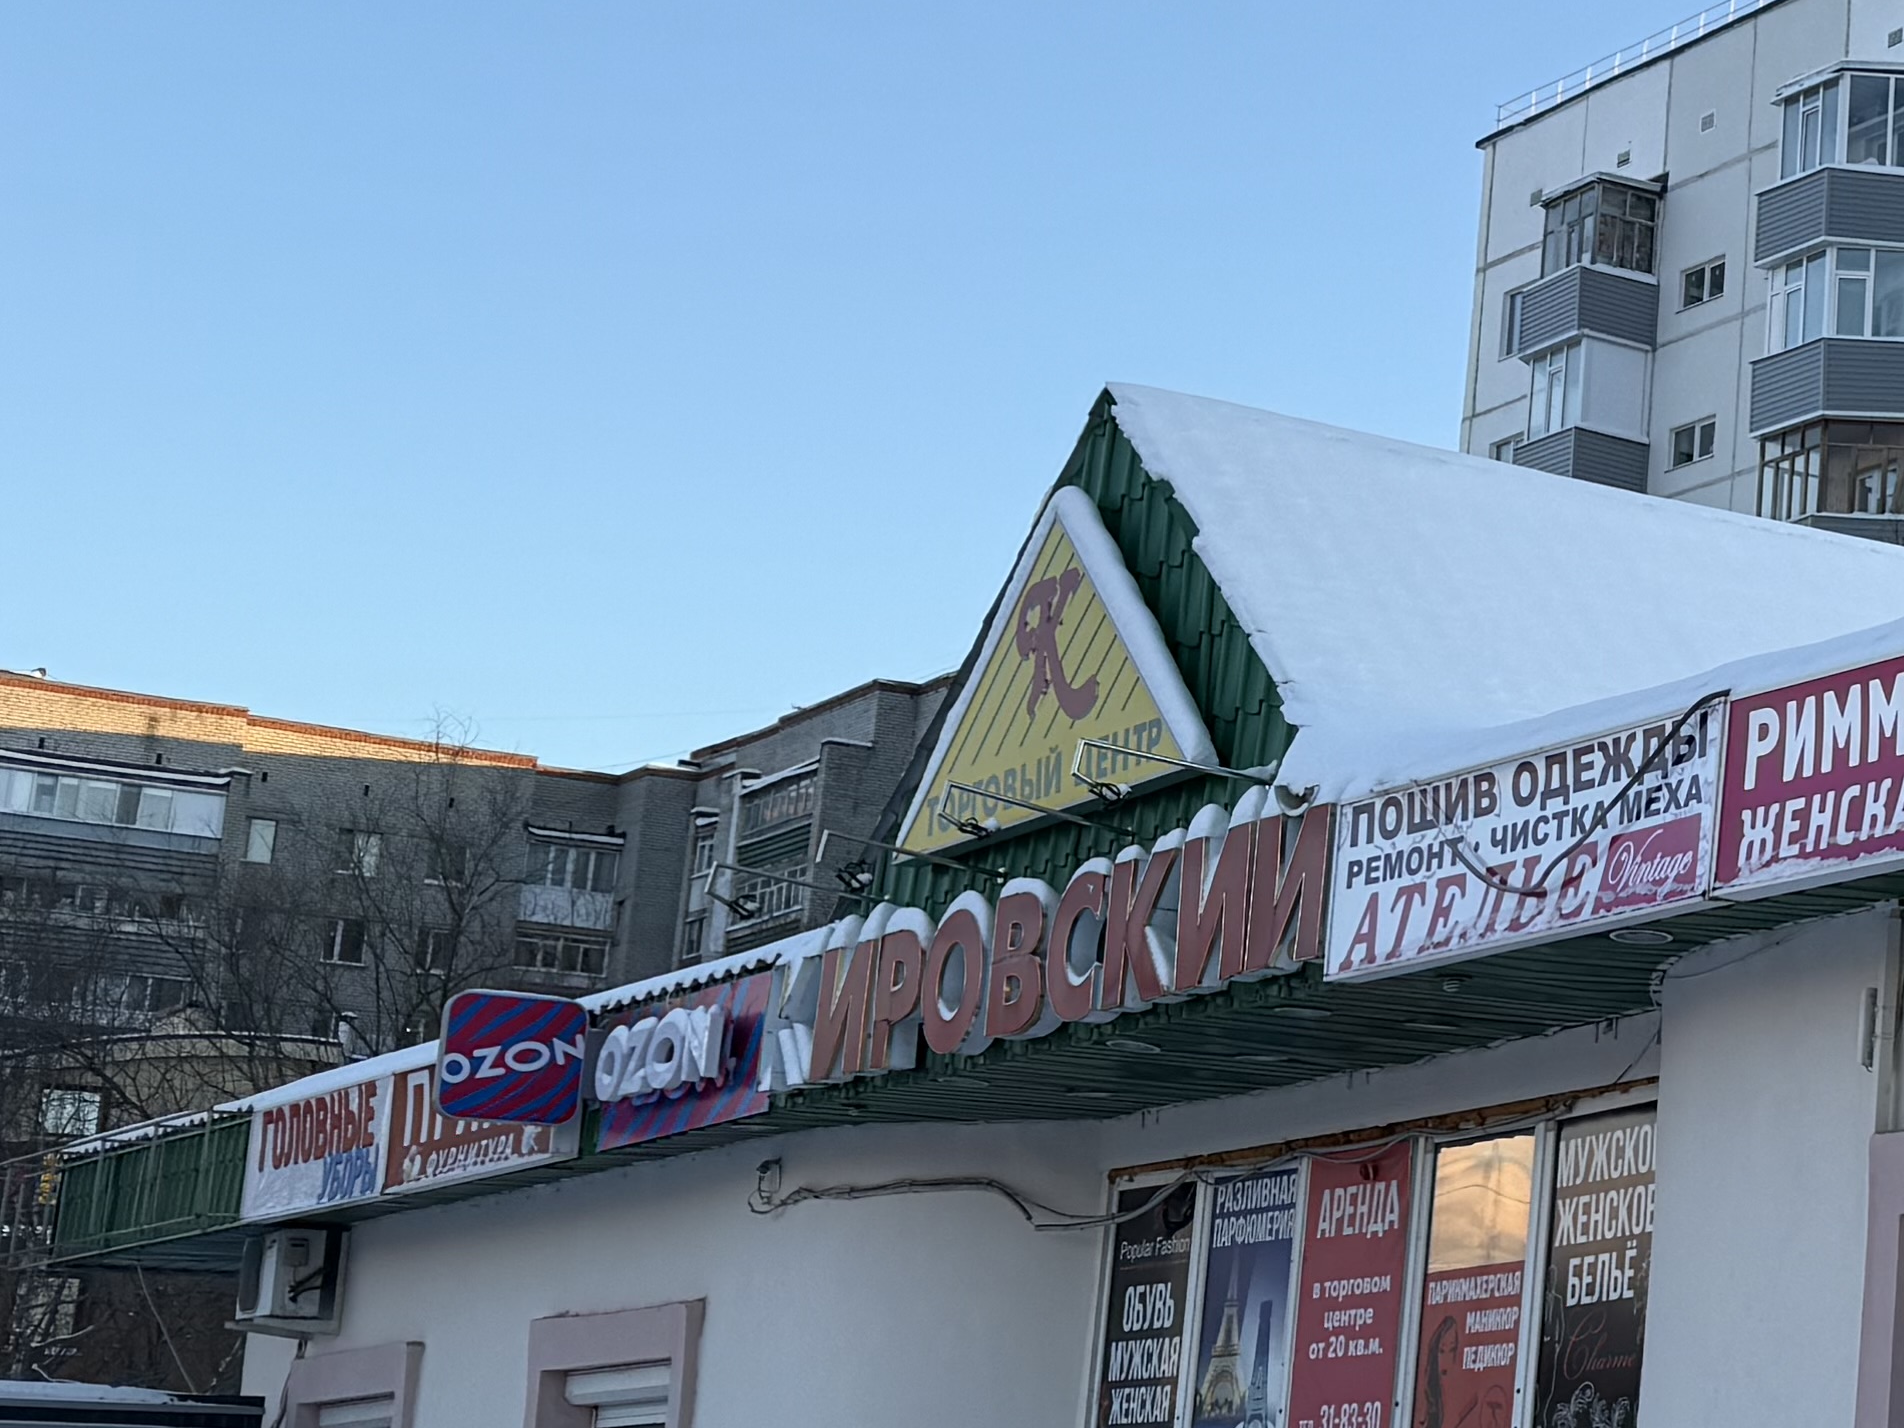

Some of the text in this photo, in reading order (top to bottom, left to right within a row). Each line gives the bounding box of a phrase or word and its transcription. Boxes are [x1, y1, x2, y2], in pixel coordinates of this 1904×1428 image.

[927, 744, 1062, 837] ТОРГОВЫЙ
[1350, 711, 1709, 848] ПОШИВ ОДЕЖДЫ
[1346, 774, 1702, 889] РЕМОНТ ЧИСТКА МЕХА
[1609, 829, 1693, 902] Vintage
[1339, 840, 1600, 973] АТЕЛЬЕ
[757, 784, 1338, 1093] КИРОВСКИЙ
[440, 1034, 585, 1084] OZON
[595, 1004, 727, 1103] OZON
[258, 1080, 378, 1173] ГОЛОВНЫЕ
[317, 1143, 380, 1205] УБОРЫ
[1557, 1123, 1657, 1188] МУЖСКО
[1216, 1174, 1297, 1214] РАЗЛИВНАЯ
[1316, 1180, 1400, 1238] АРЕНДА
[1120, 1239, 1154, 1263] Popular
[1212, 1208, 1296, 1248] ПАРФЮМЕРИЯ
[1324, 1275, 1391, 1301] торговом
[1566, 1241, 1638, 1308] БЕЛЬЁ
[1122, 1281, 1175, 1332] ОБУВЬ
[1323, 1308, 1374, 1331] центре
[1465, 1306, 1519, 1333] МАНИКЮР
[1108, 1336, 1181, 1382] МУЖСКАЯ
[1308, 1342, 1326, 1359] от
[1327, 1336, 1346, 1357] 20
[1462, 1342, 1515, 1371] ПЕДИКЮР
[1109, 1385, 1171, 1425] ЖЕНСКАЯ
